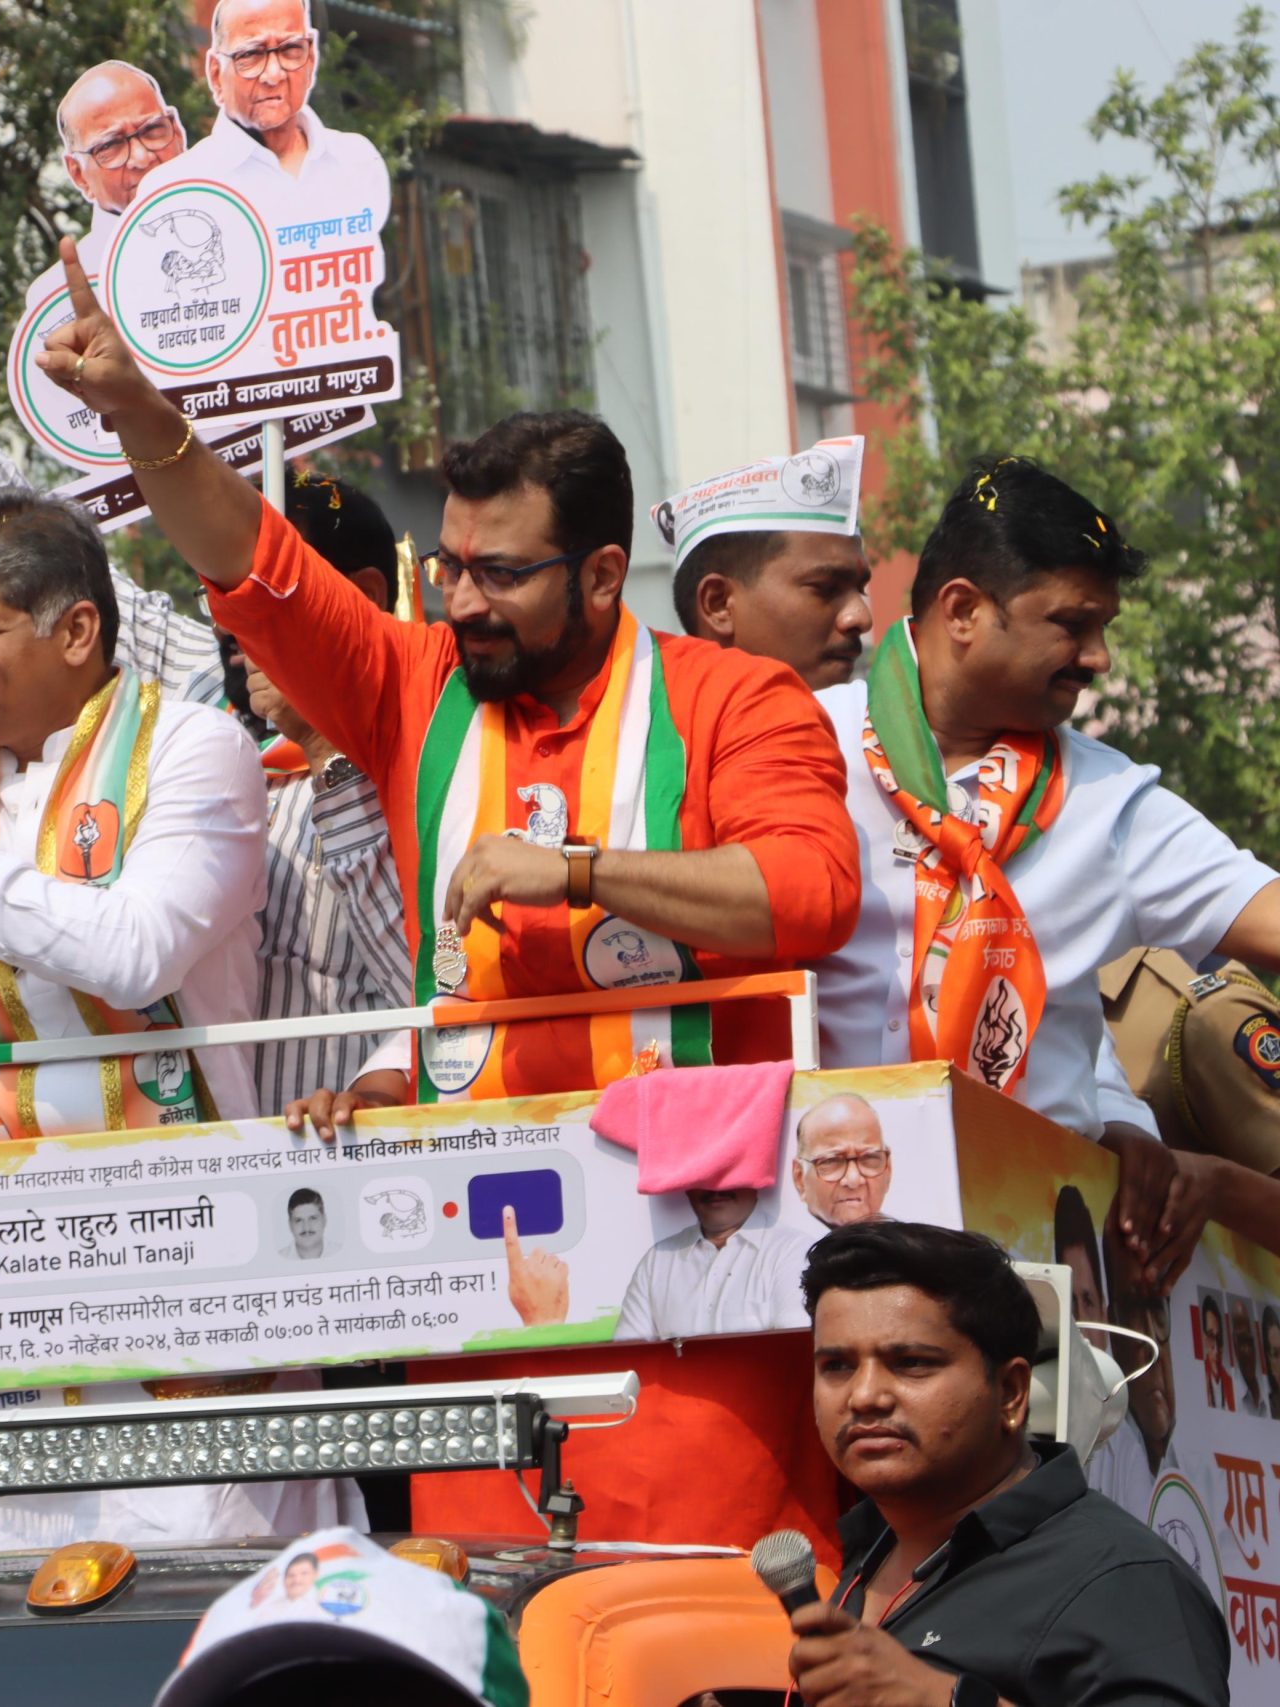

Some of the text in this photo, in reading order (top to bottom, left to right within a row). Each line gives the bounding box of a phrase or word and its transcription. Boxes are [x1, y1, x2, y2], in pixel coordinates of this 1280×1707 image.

[275, 208, 374, 249] रामकृष्ण हरी
[280, 246, 375, 293] वाजवा
[140, 297, 241, 329] राष्ट्रवादी काँग्रेस पक्ष
[158, 324, 226, 350] शरदचंद्र पवार
[182, 366, 379, 419] तुतारी वाजवणारा माणुस
[14, 1167, 85, 1189] मतदारसंघ
[88, 1160, 143, 1187] राष्ट्रवादी
[148, 1156, 194, 1180] काँग्रेस
[197, 1154, 221, 1174] पक्ष
[227, 1148, 282, 1171] शरदचंद्र
[287, 1148, 320, 1166] पवार
[326, 1147, 337, 1163] व
[342, 1136, 423, 1162] महाविकास
[428, 1129, 498, 1154] आघाडीचे
[502, 1125, 561, 1148] उमेदवार
[55, 1211, 118, 1250] राहुल
[127, 1195, 215, 1234] तानाजी
[69, 1247, 127, 1270] Rahul
[134, 1241, 195, 1266] Tanaji
[9, 1307, 64, 1334] माणूस
[68, 1295, 184, 1326] चिन्हासमोरील
[187, 1296, 227, 1316] बटन
[232, 1291, 277, 1319] दाबून
[282, 1283, 324, 1309] प्रचंड
[328, 1278, 381, 1304] मतांनी
[386, 1271, 443, 1300] विजयी
[448, 1273, 486, 1294] करा
[44, 1341, 64, 1357] २०
[69, 1333, 120, 1356] नोव्हेंबर
[174, 1326, 200, 1348] वेळ
[205, 1321, 259, 1345] सकाळी
[264, 1322, 313, 1340] ०७:००
[317, 1315, 331, 1336] ते
[335, 1309, 406, 1334] सायंकाळी
[411, 1311, 459, 1328] ०६:००
